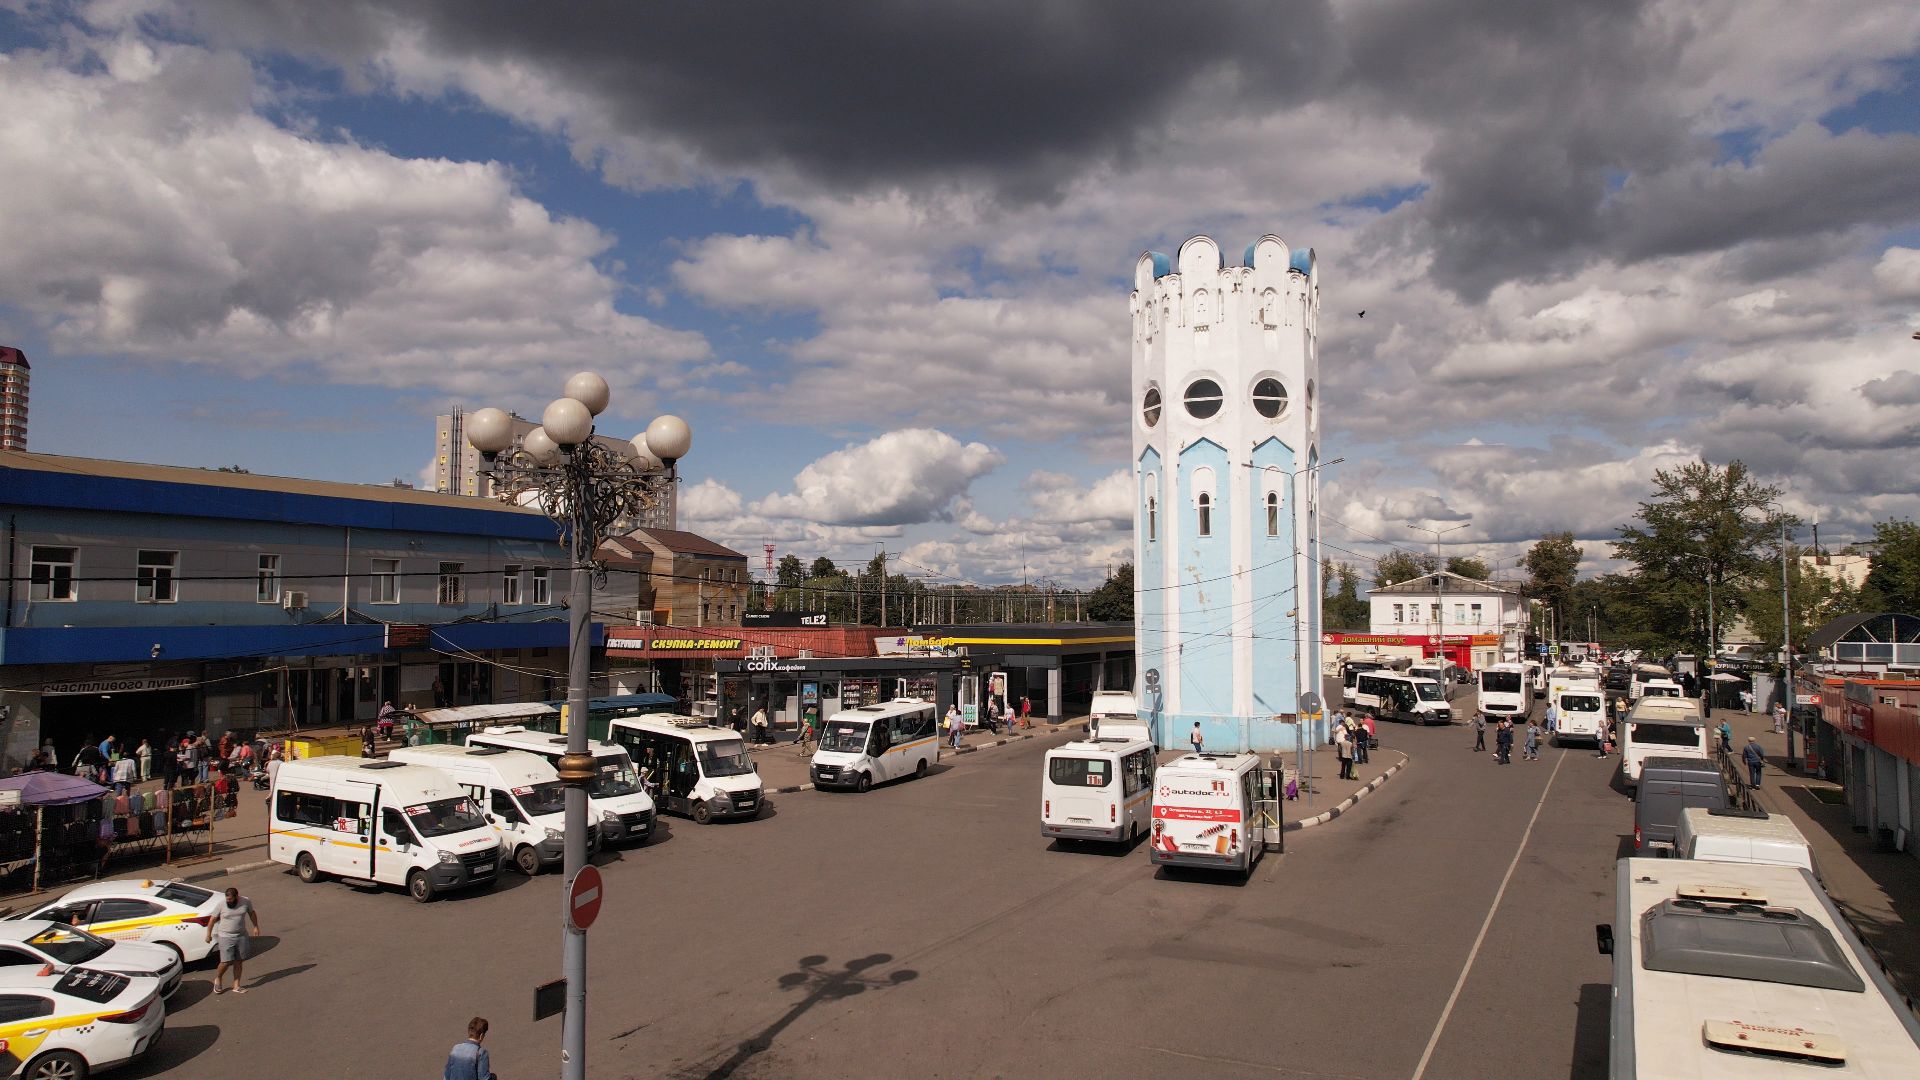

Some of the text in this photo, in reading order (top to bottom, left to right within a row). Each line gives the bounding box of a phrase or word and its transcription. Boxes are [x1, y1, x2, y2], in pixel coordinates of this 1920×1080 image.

[801, 614, 827, 625] TELE2
[747, 659, 778, 672] cofix
[42, 680, 143, 692] счастливого
[1211, 780, 1225, 791] 11
